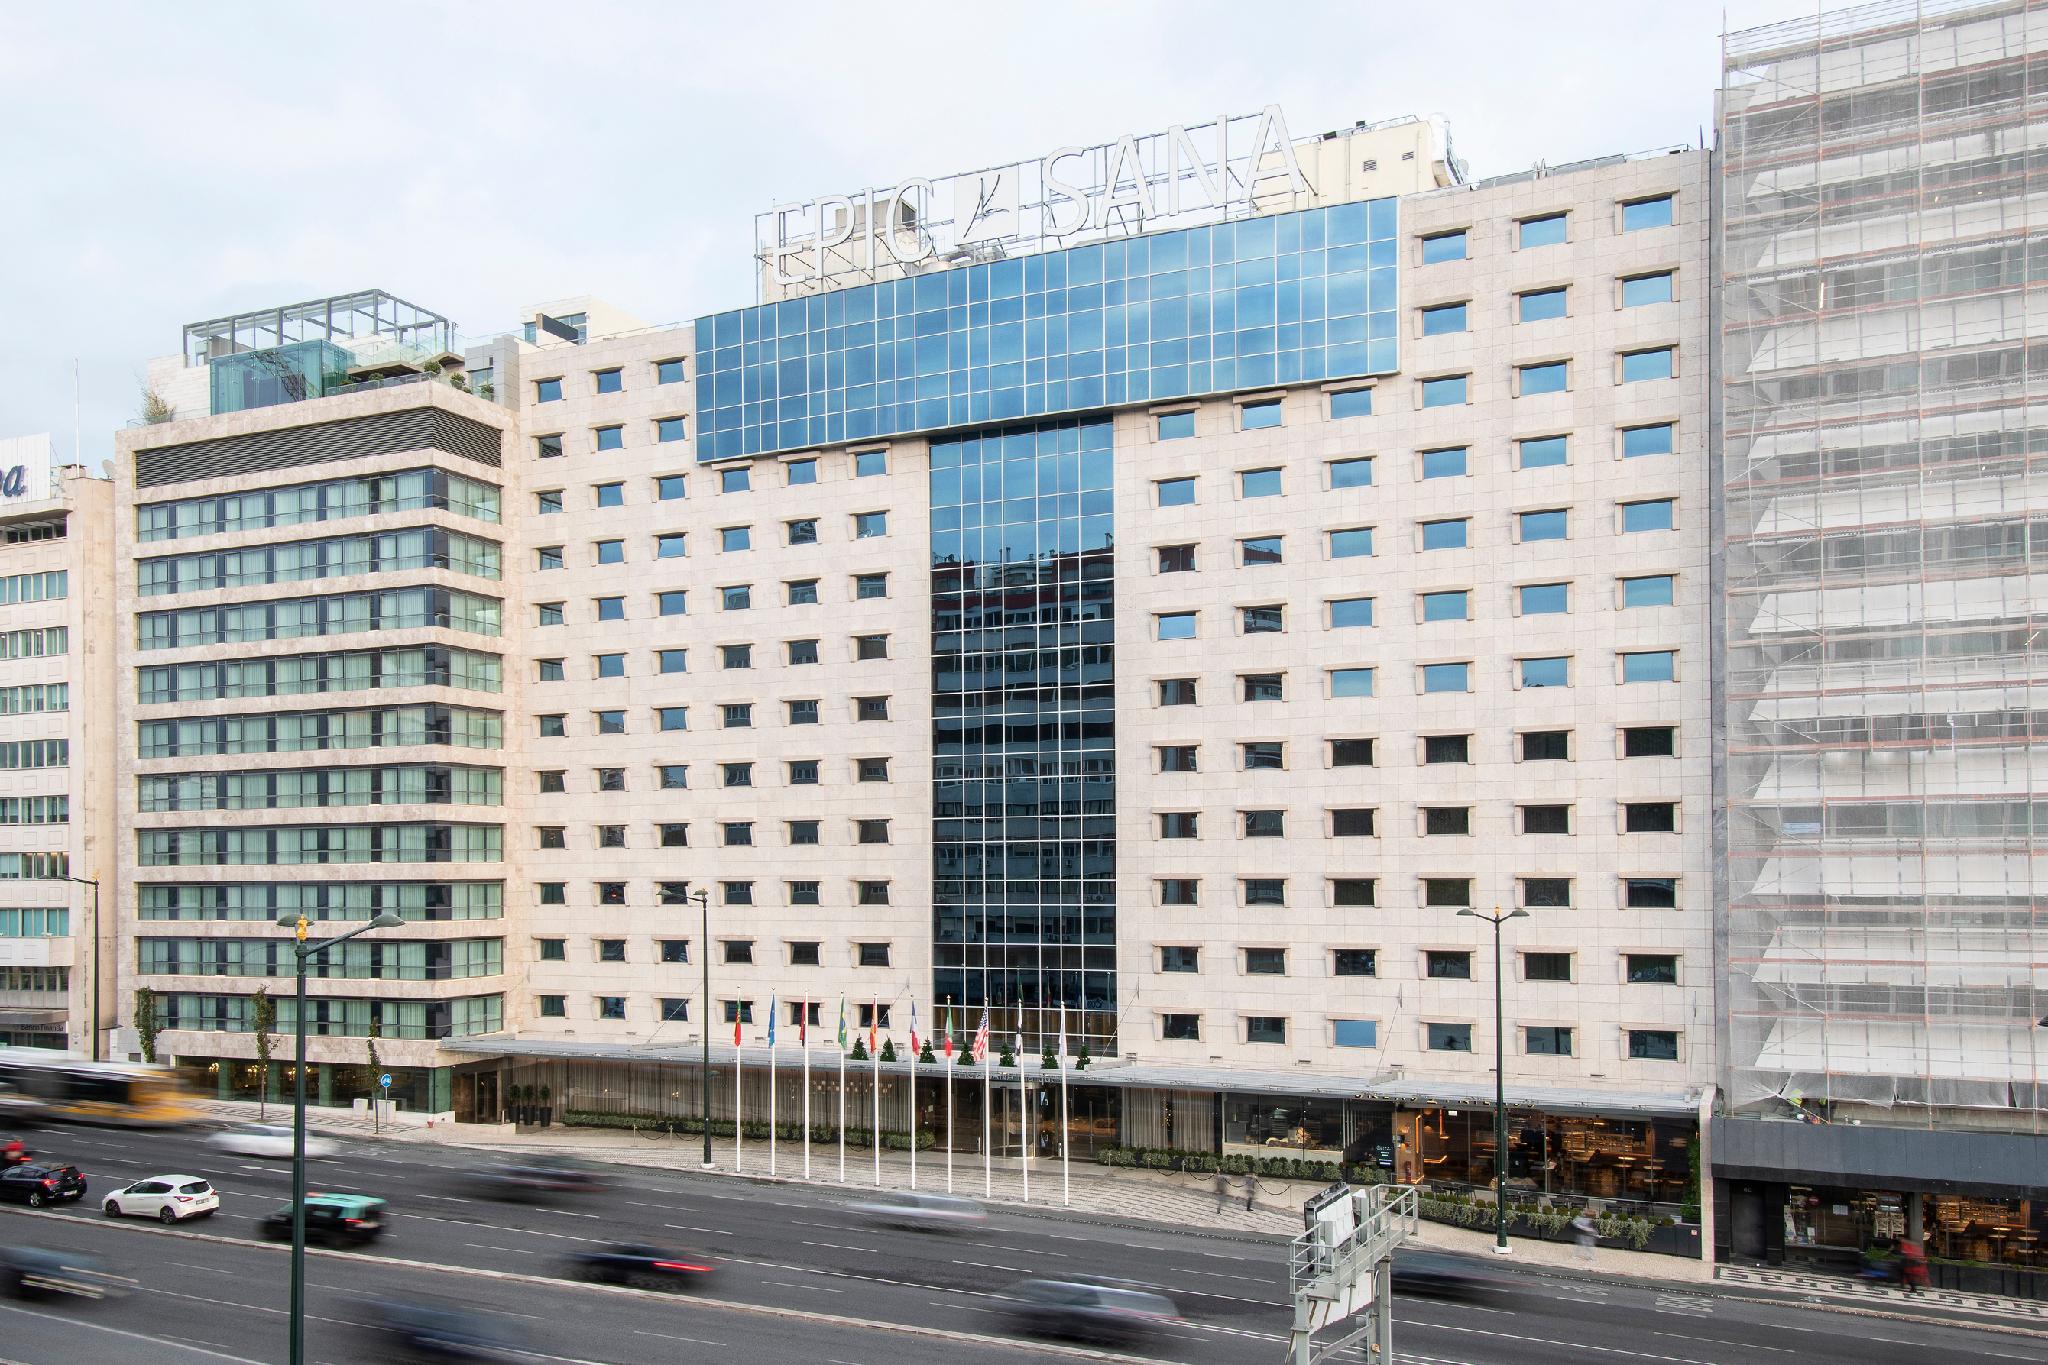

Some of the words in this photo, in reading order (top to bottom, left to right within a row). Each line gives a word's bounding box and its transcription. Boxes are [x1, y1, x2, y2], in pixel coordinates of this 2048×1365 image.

[772, 176, 934, 286] EPIC
[1041, 103, 1306, 237] SANA
[0, 464, 27, 498] a
